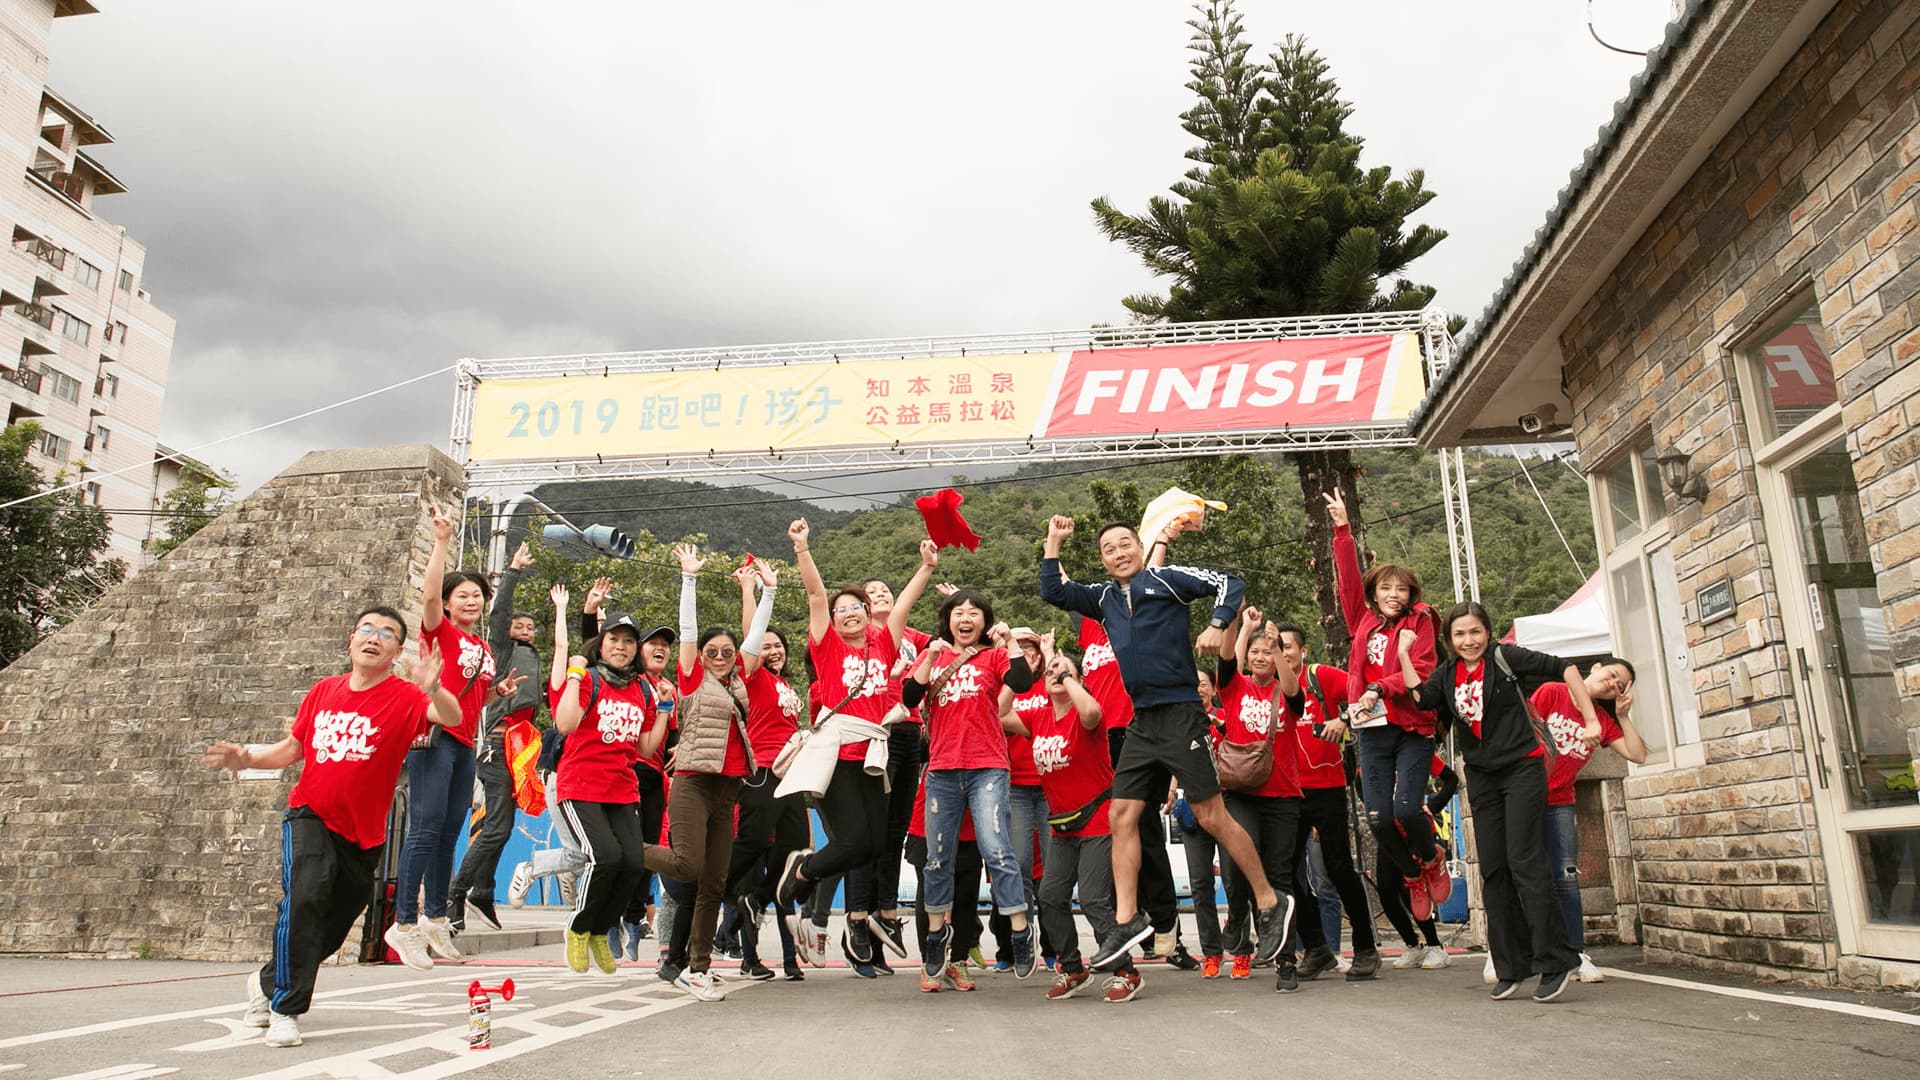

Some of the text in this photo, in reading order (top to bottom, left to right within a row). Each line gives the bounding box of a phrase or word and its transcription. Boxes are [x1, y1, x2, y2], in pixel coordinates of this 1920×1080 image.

[865, 372, 1015, 398] 知本溫泉
[1073, 357, 1364, 415] FINISH
[507, 398, 620, 437] 2019
[865, 400, 1016, 425] 公益馬拉松
